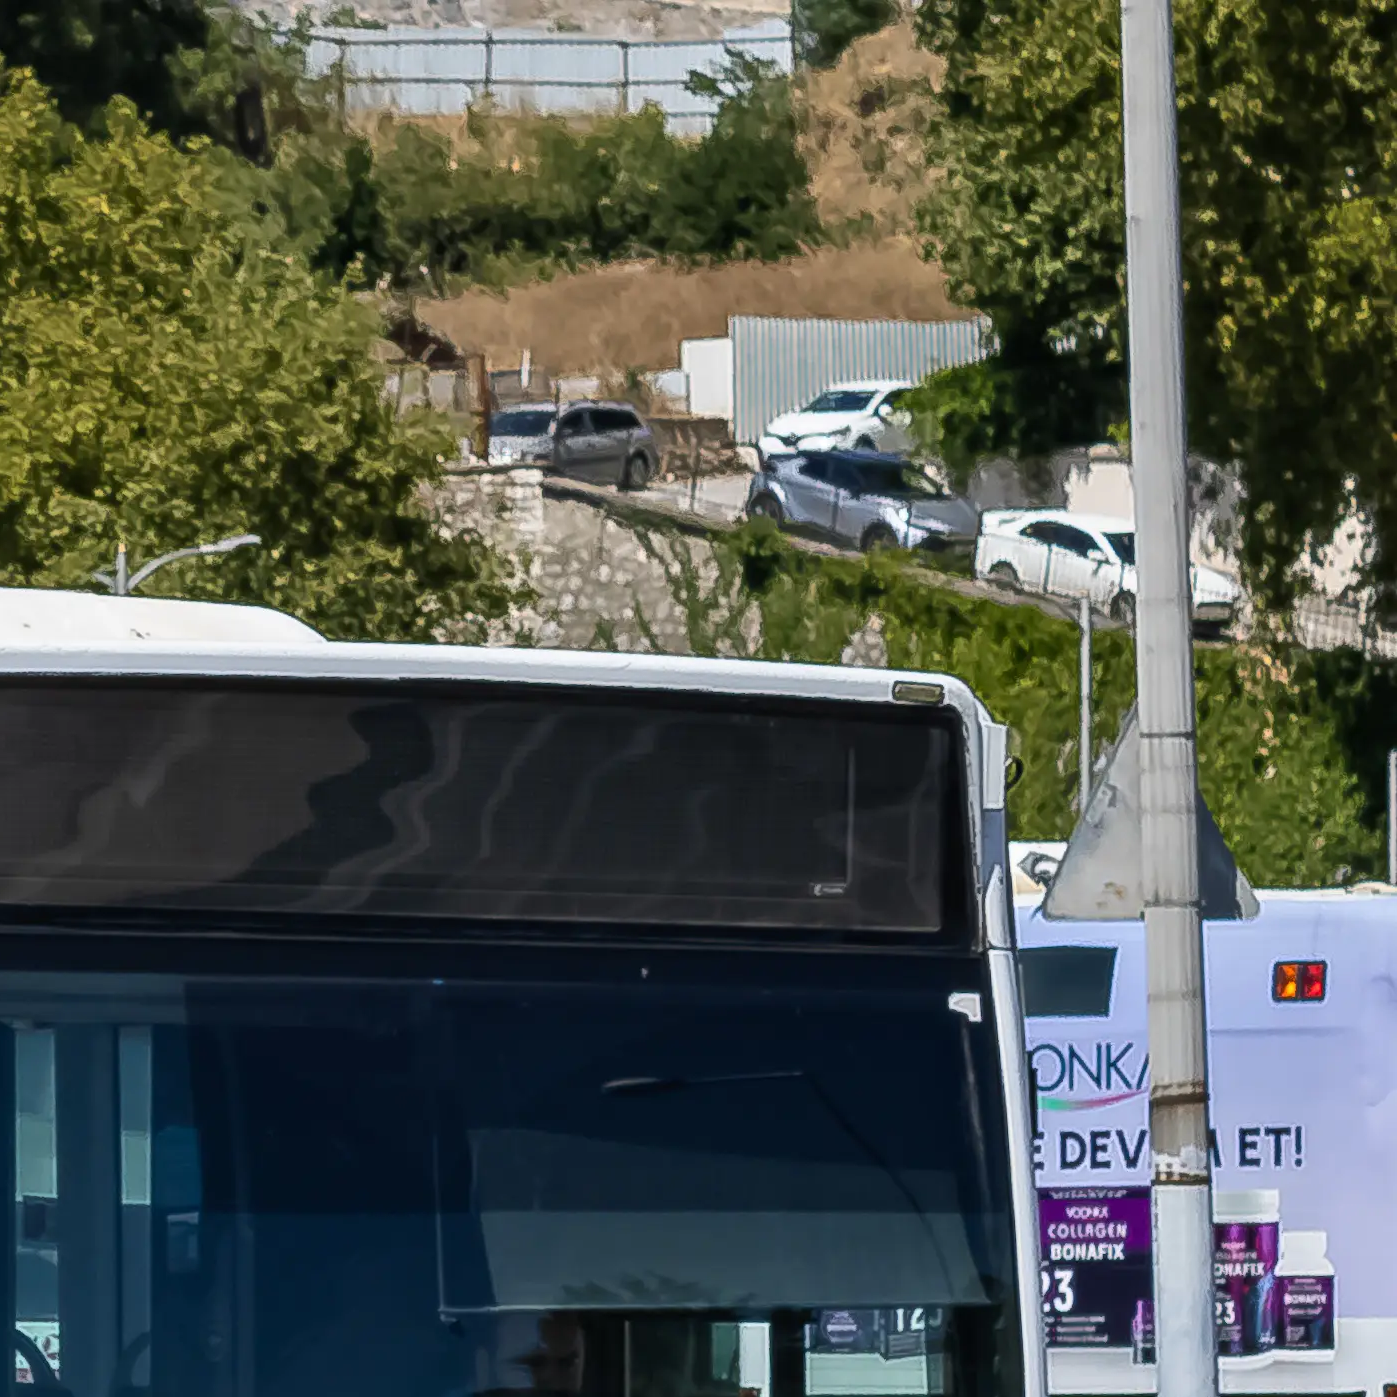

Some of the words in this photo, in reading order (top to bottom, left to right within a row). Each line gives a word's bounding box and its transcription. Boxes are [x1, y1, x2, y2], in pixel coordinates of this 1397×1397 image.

[1033, 1042, 1150, 1092] ONK
[1238, 1125, 1303, 1169] ET!
[1047, 1222, 1128, 1239] COLLAGEN
[1050, 1243, 1126, 1261] BONAFIX
